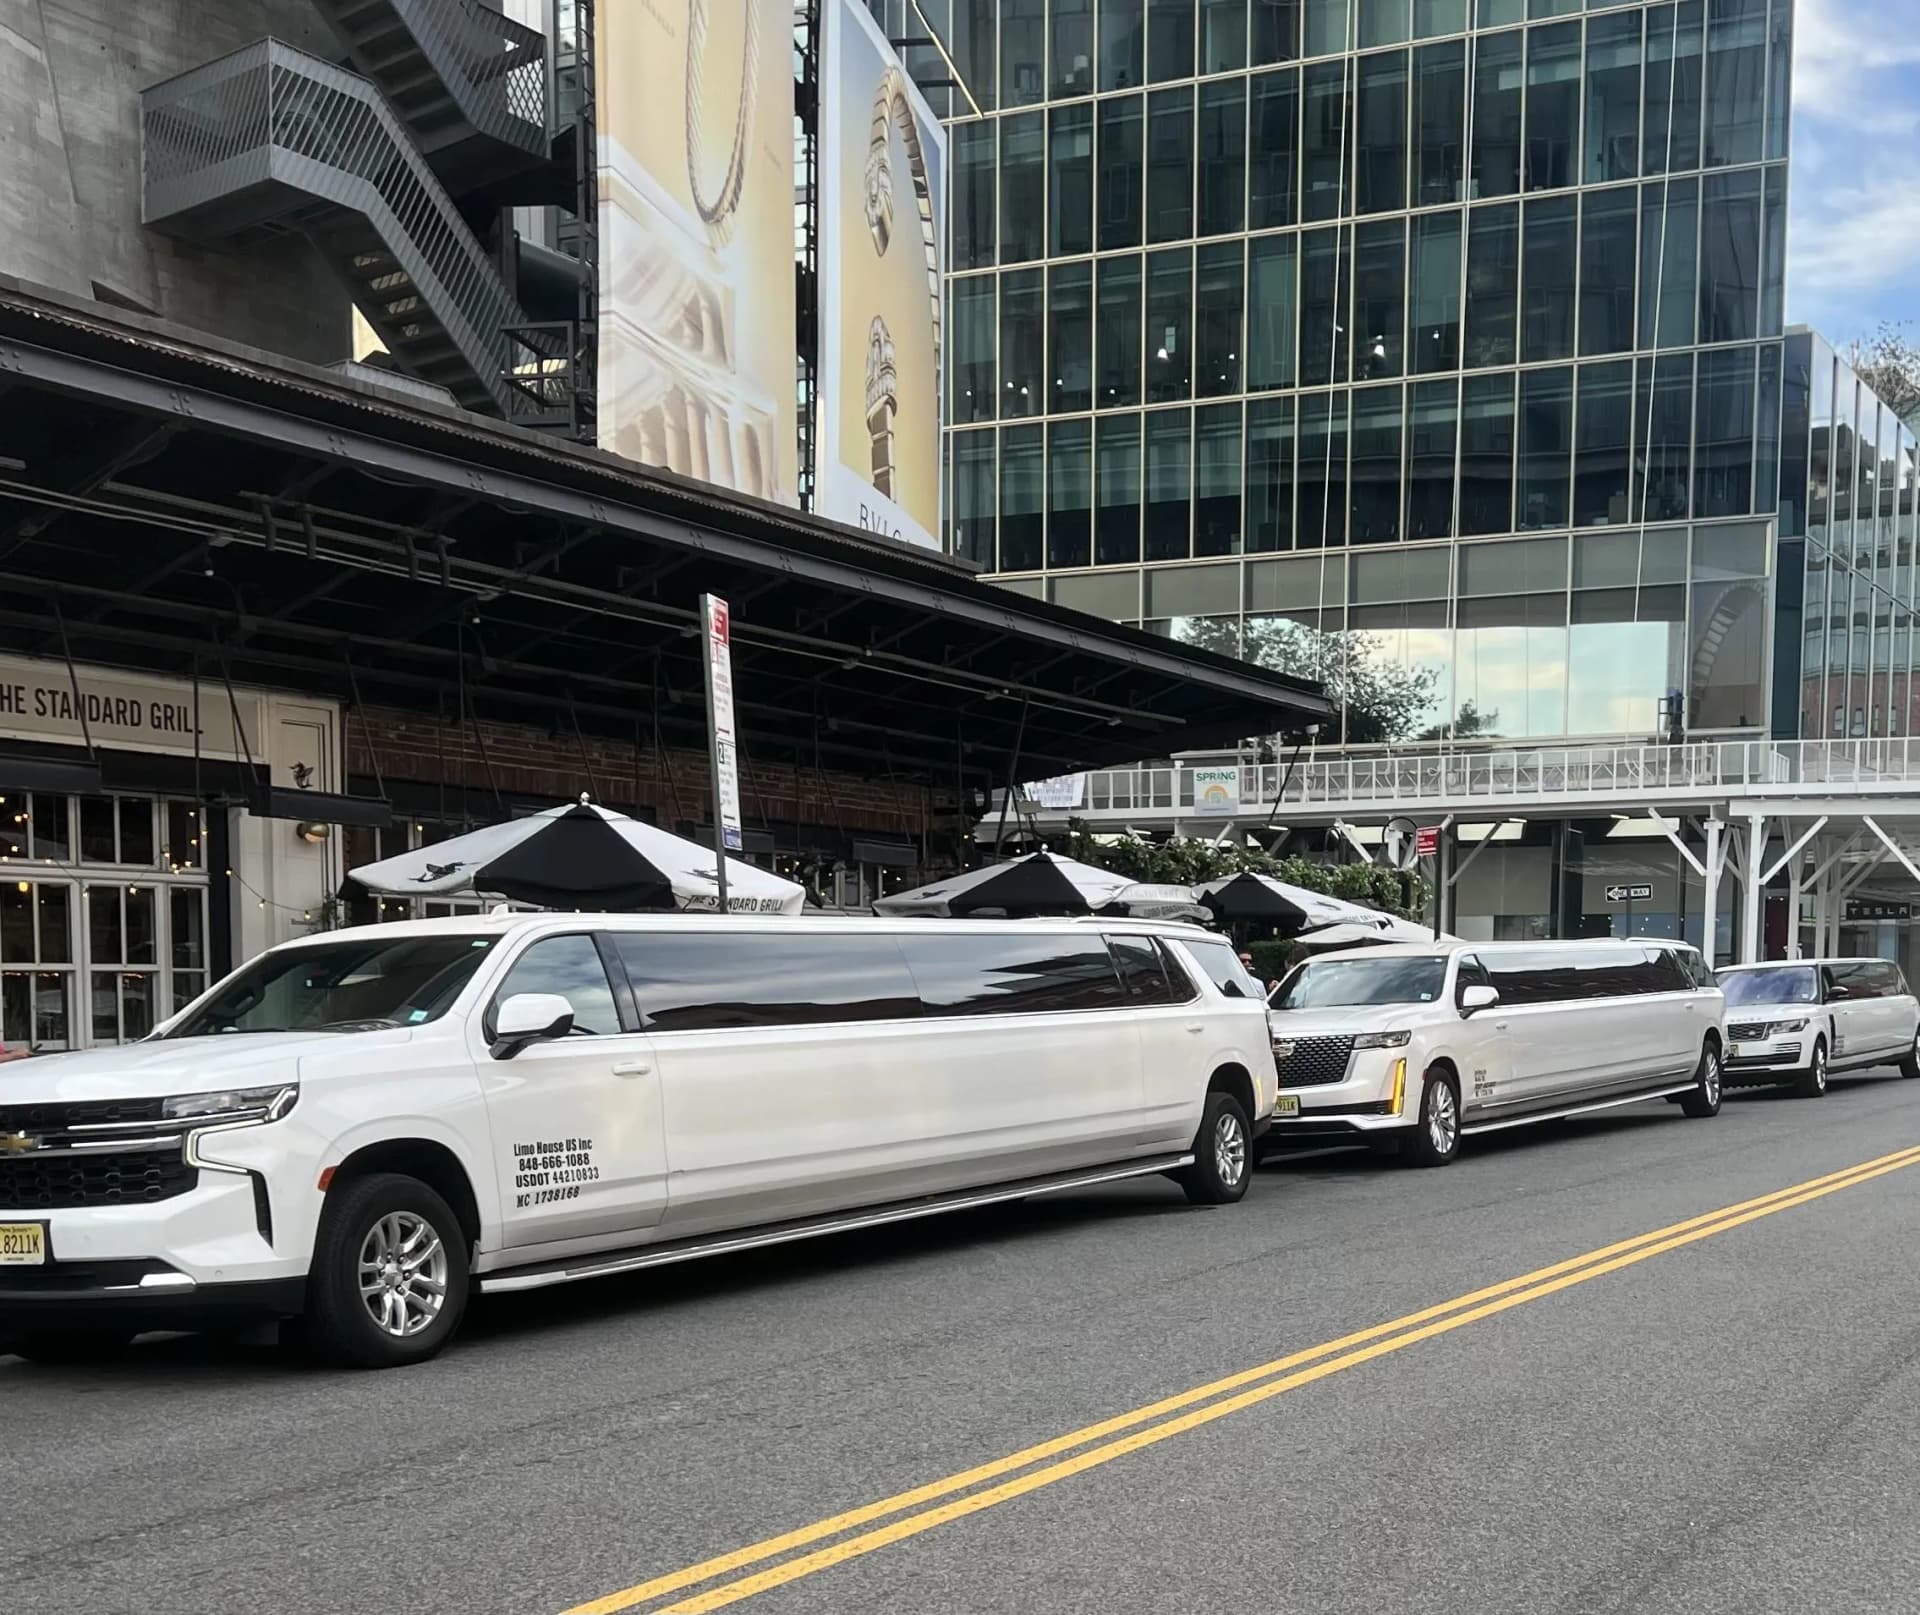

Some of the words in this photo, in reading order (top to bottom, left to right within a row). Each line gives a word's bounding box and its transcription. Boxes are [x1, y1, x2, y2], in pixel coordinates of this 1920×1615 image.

[0, 684, 27, 714] HE
[35, 688, 142, 727] STANDARD
[151, 702, 204, 734] GRIL
[1196, 771, 1236, 781] SPRING
[1849, 907, 1908, 915] TESLA
[513, 1143, 535, 1156] Limo
[536, 1141, 564, 1155] House
[565, 1138, 577, 1151] US
[578, 1138, 592, 1150] Inc
[516, 1172, 550, 1188] USDOT
[552, 1166, 599, 1184] 44210833
[0, 1234, 40, 1254] 8211K
